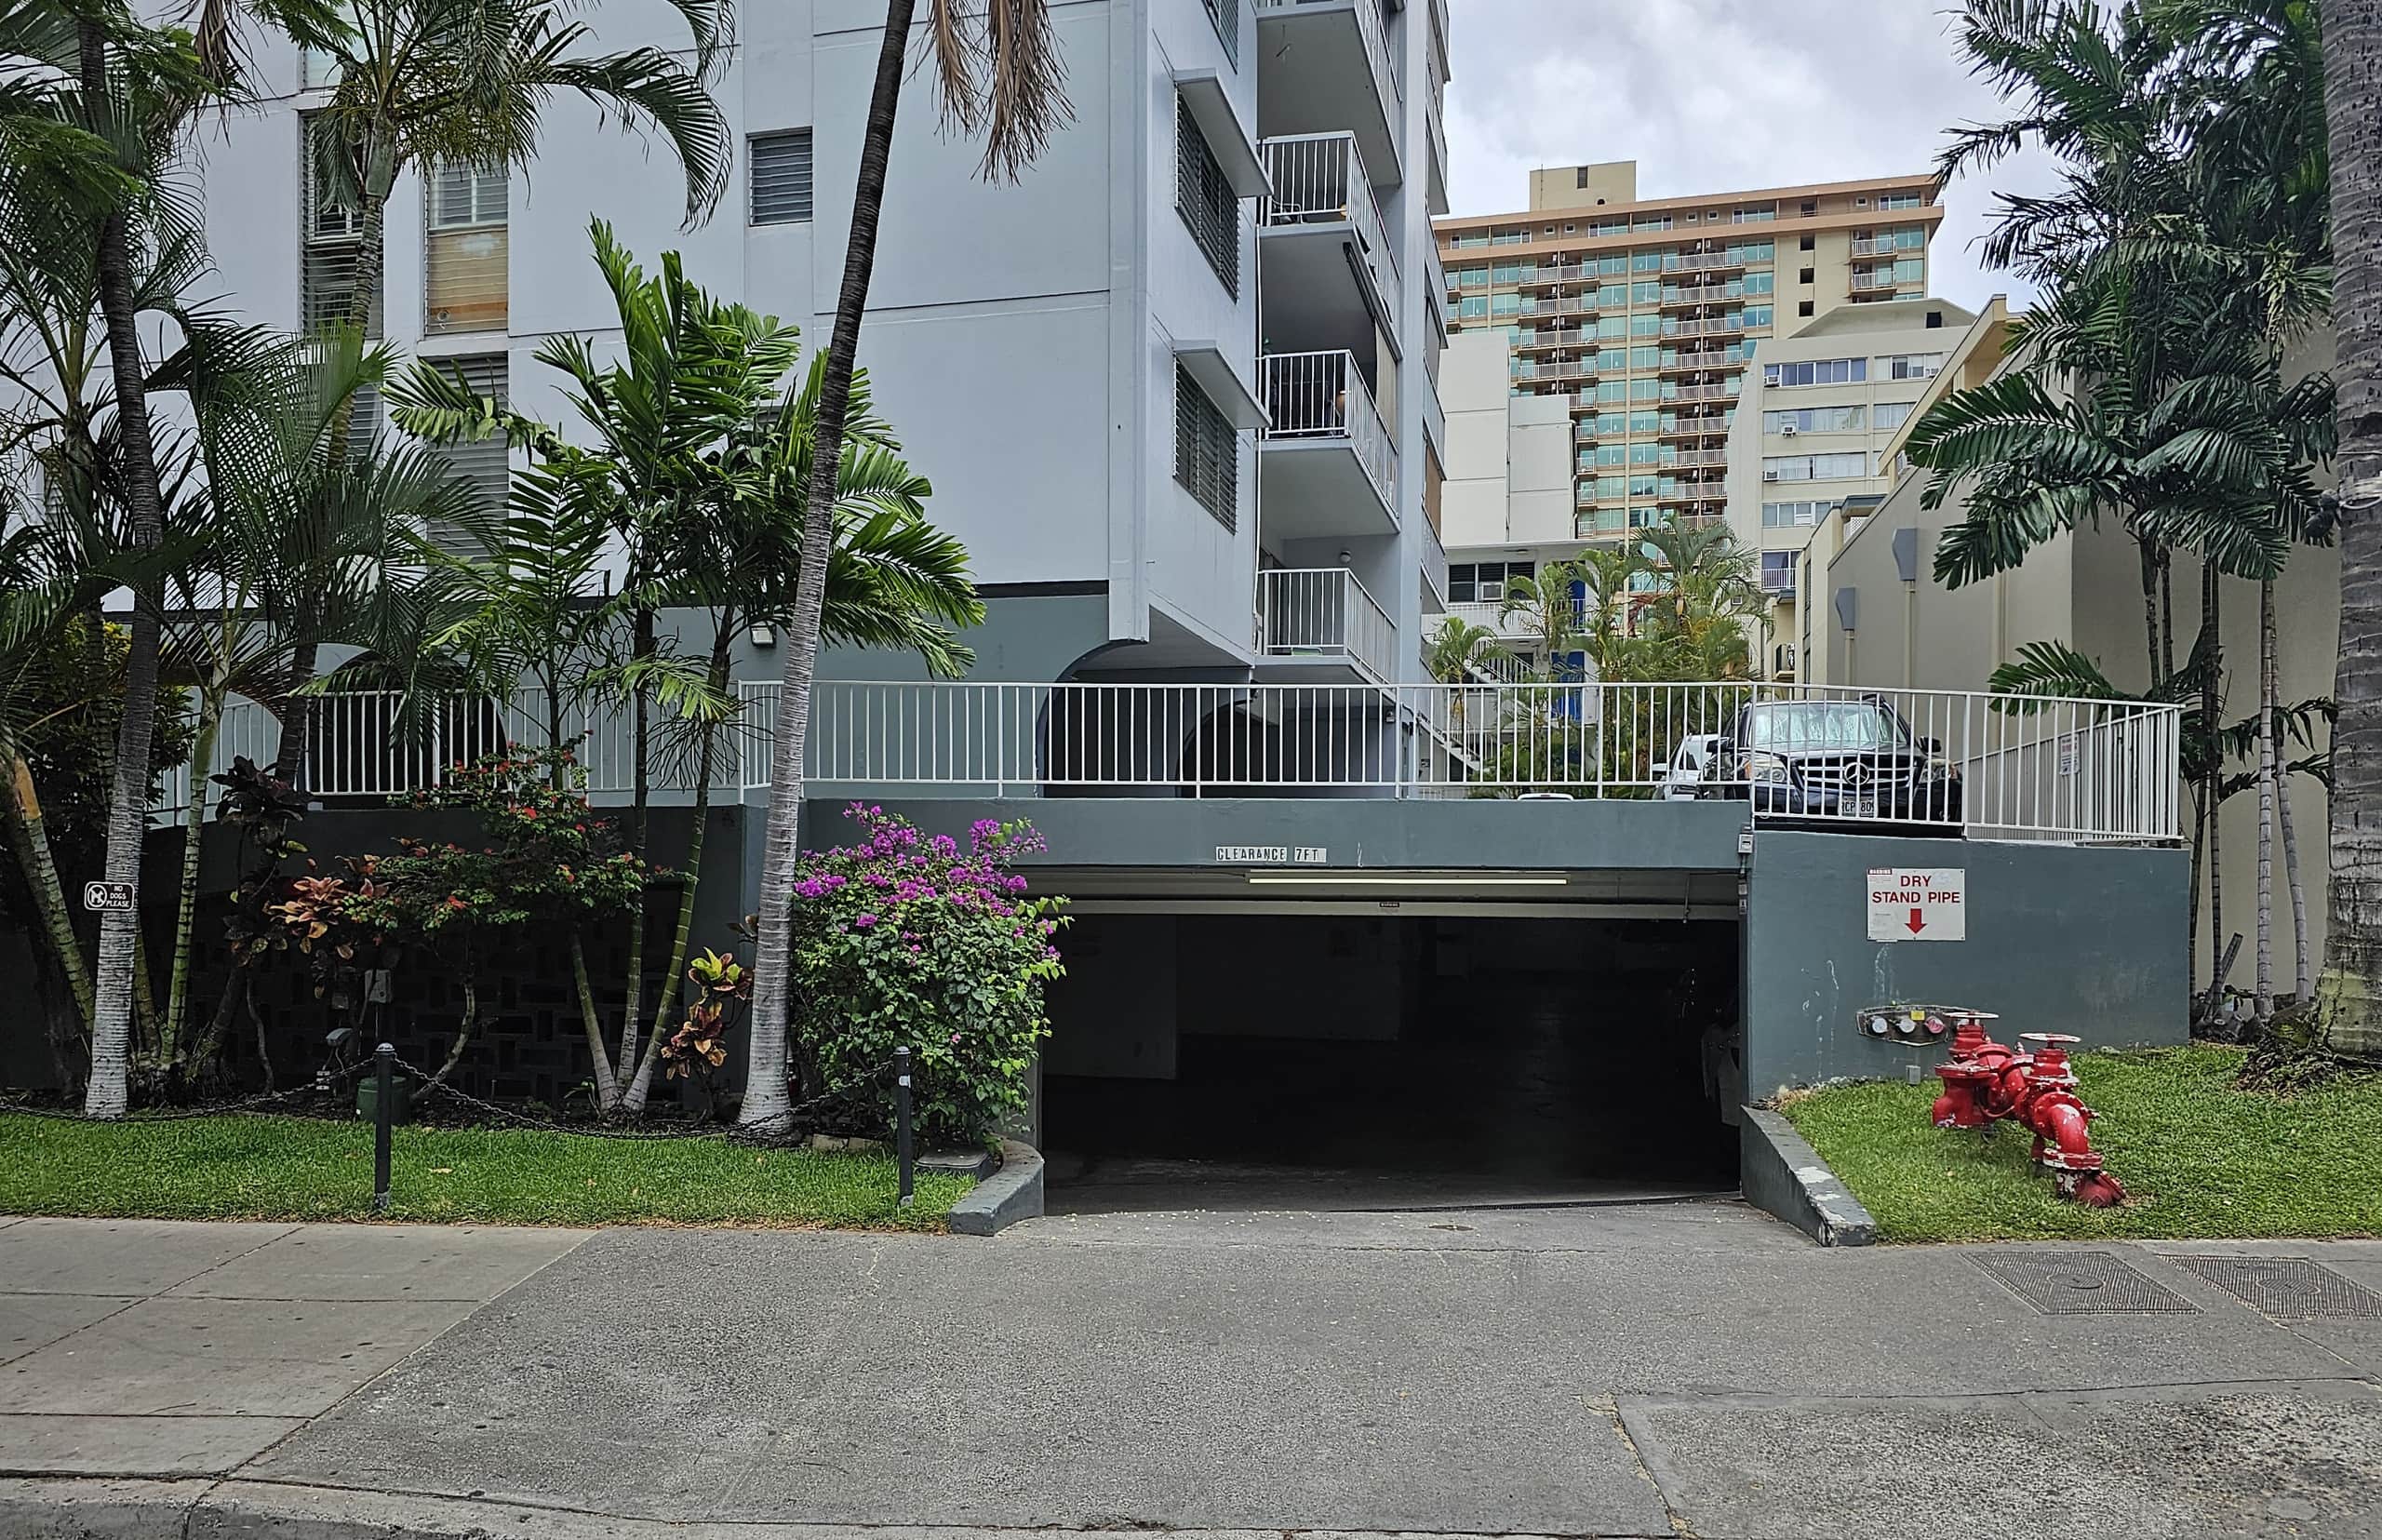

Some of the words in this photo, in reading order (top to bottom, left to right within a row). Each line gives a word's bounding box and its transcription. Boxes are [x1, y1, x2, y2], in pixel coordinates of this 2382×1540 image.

[1217, 848, 1285, 860] CLEARANCE
[1295, 849, 1318, 861] 7FT
[1900, 876, 1931, 887] DRY
[1872, 891, 1921, 904] STAND
[1928, 891, 1960, 904] PIPE
